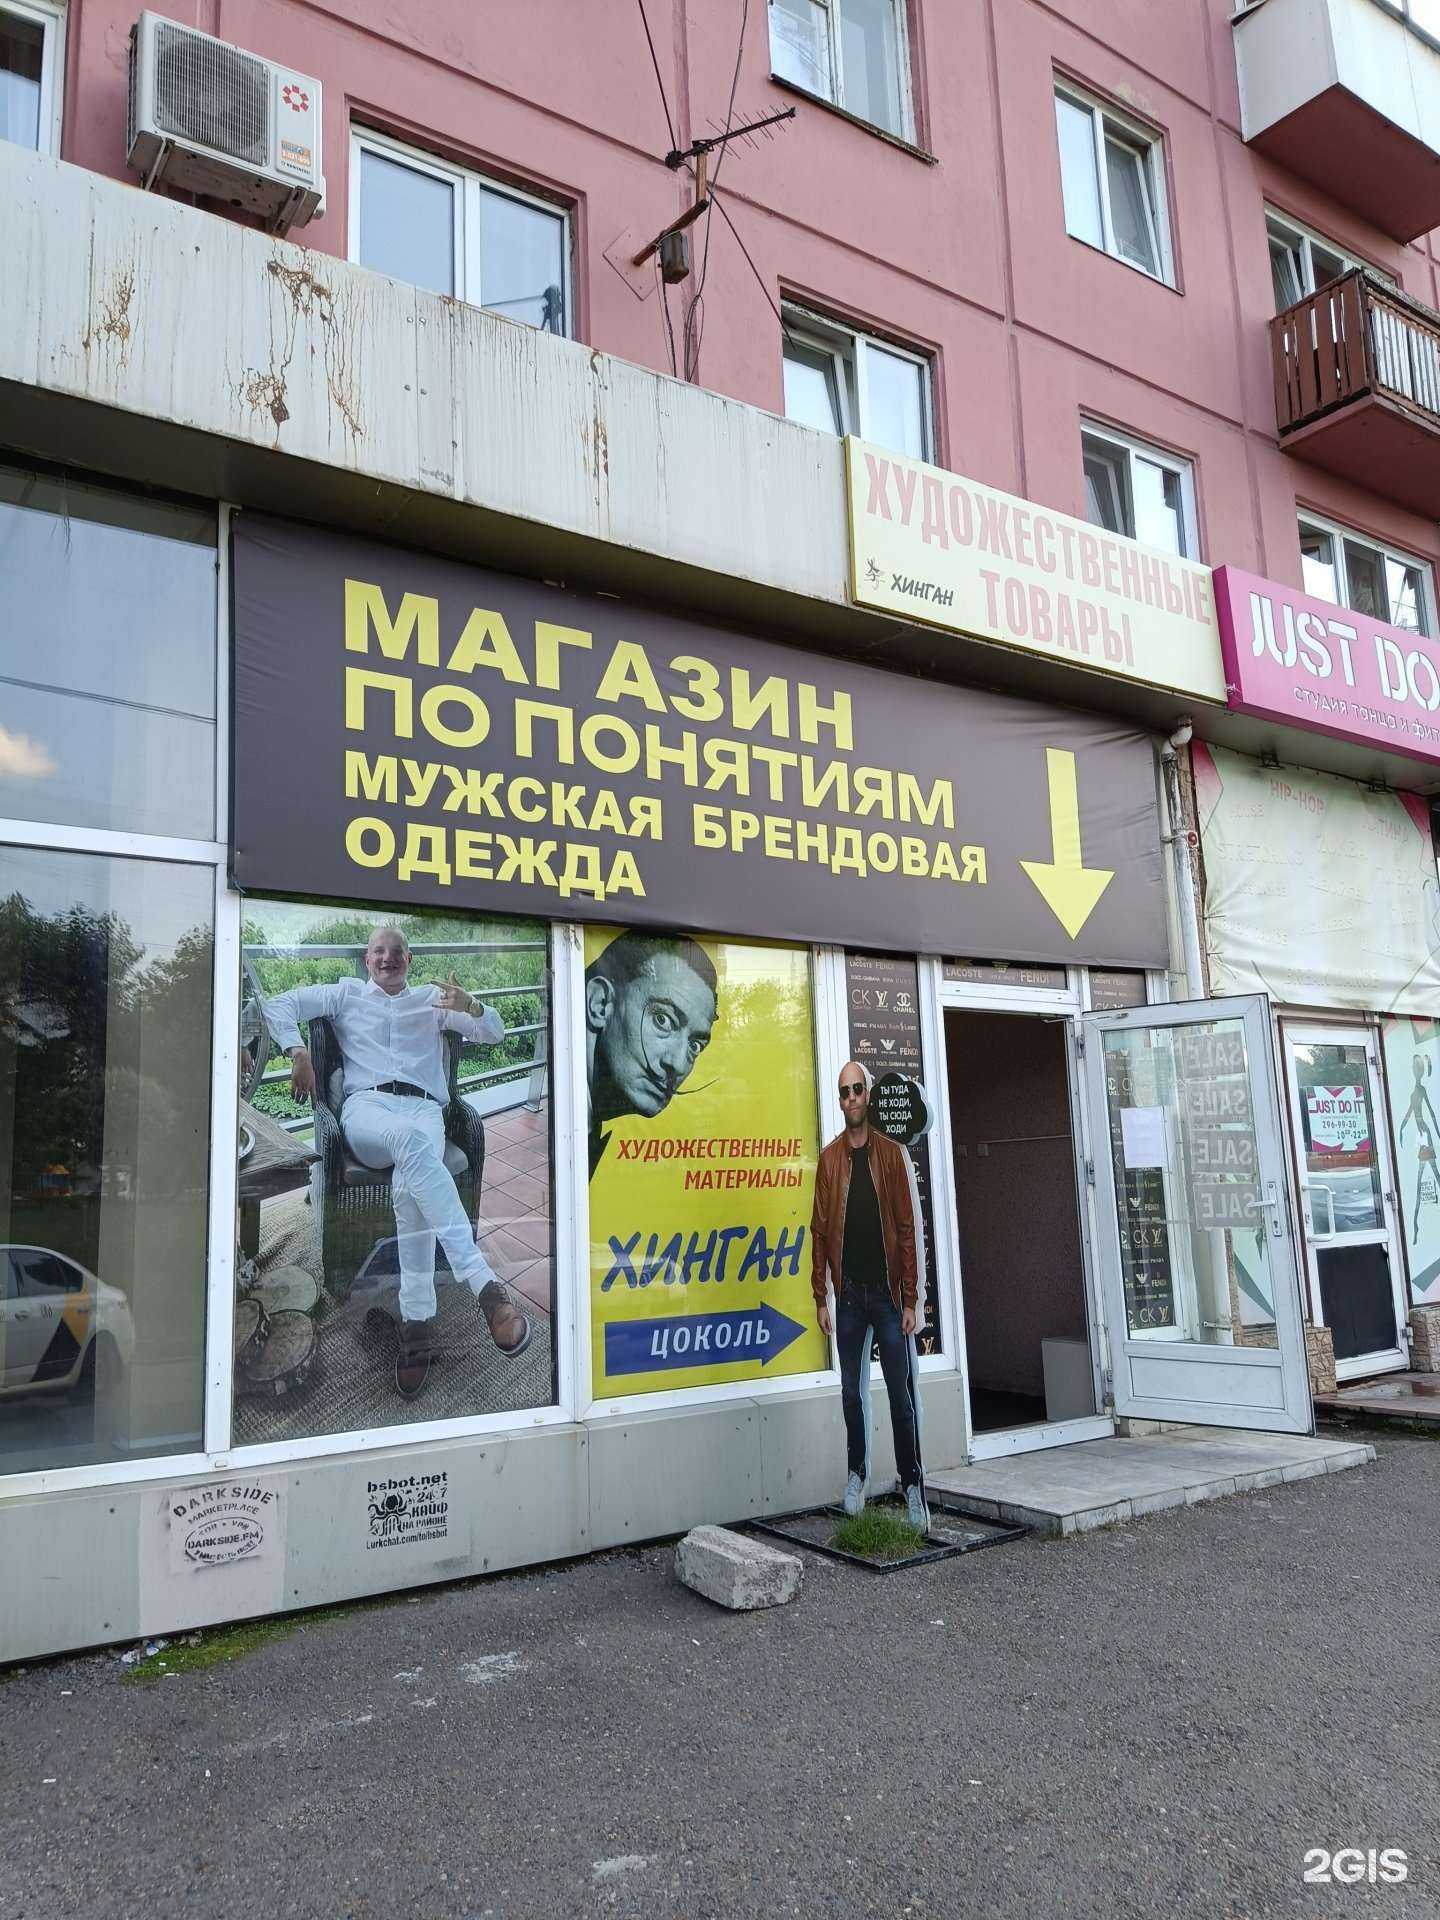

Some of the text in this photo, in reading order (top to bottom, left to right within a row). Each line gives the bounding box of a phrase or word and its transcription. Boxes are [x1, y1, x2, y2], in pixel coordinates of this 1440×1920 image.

[864, 452, 1212, 626] ХУДОЖЕСТВЕННЫЕ
[890, 573, 954, 607] ХИНГАН
[979, 568, 1135, 667] ТОВАРЫ
[1249, 591, 1440, 712] JUST DO
[345, 578, 853, 751] МАГАЗИН
[345, 666, 955, 829] ПО ПОНЯТИЯМ
[1270, 779, 1325, 815] HIP-HOP
[345, 750, 988, 884] МУЖСКАЯ БРЕНДОВАЯ
[345, 817, 646, 902] ОДЕЖДА
[946, 967, 983, 978] LACOSTE
[1020, 970, 1049, 984] FENDI
[851, 989, 871, 1006] CK
[893, 1006, 916, 1014] CHANEL
[900, 1047, 919, 1056] FENDI
[880, 1085, 909, 1095] ТЫ ТУДА
[879, 1098, 912, 1108] НЕ ХОДИ,
[1308, 1099, 1365, 1113] JUST DO IT
[880, 1111, 912, 1121] ТЫ СЮДА
[886, 1124, 907, 1134] ХОДИ
[617, 1138, 802, 1162] ХУДОЖЕСТВЕННЫЕ
[684, 1168, 803, 1190] МАТЕРИАЛЫ
[1133, 1230, 1149, 1244] CK
[601, 1225, 805, 1293] ХИНГАН
[1140, 1308, 1156, 1322] CK
[651, 1319, 771, 1359] ЦОКОЛЬ
[368, 1472, 447, 1493] bsbot.net
[187, 1530, 260, 1549] DARKSIDE.FM
